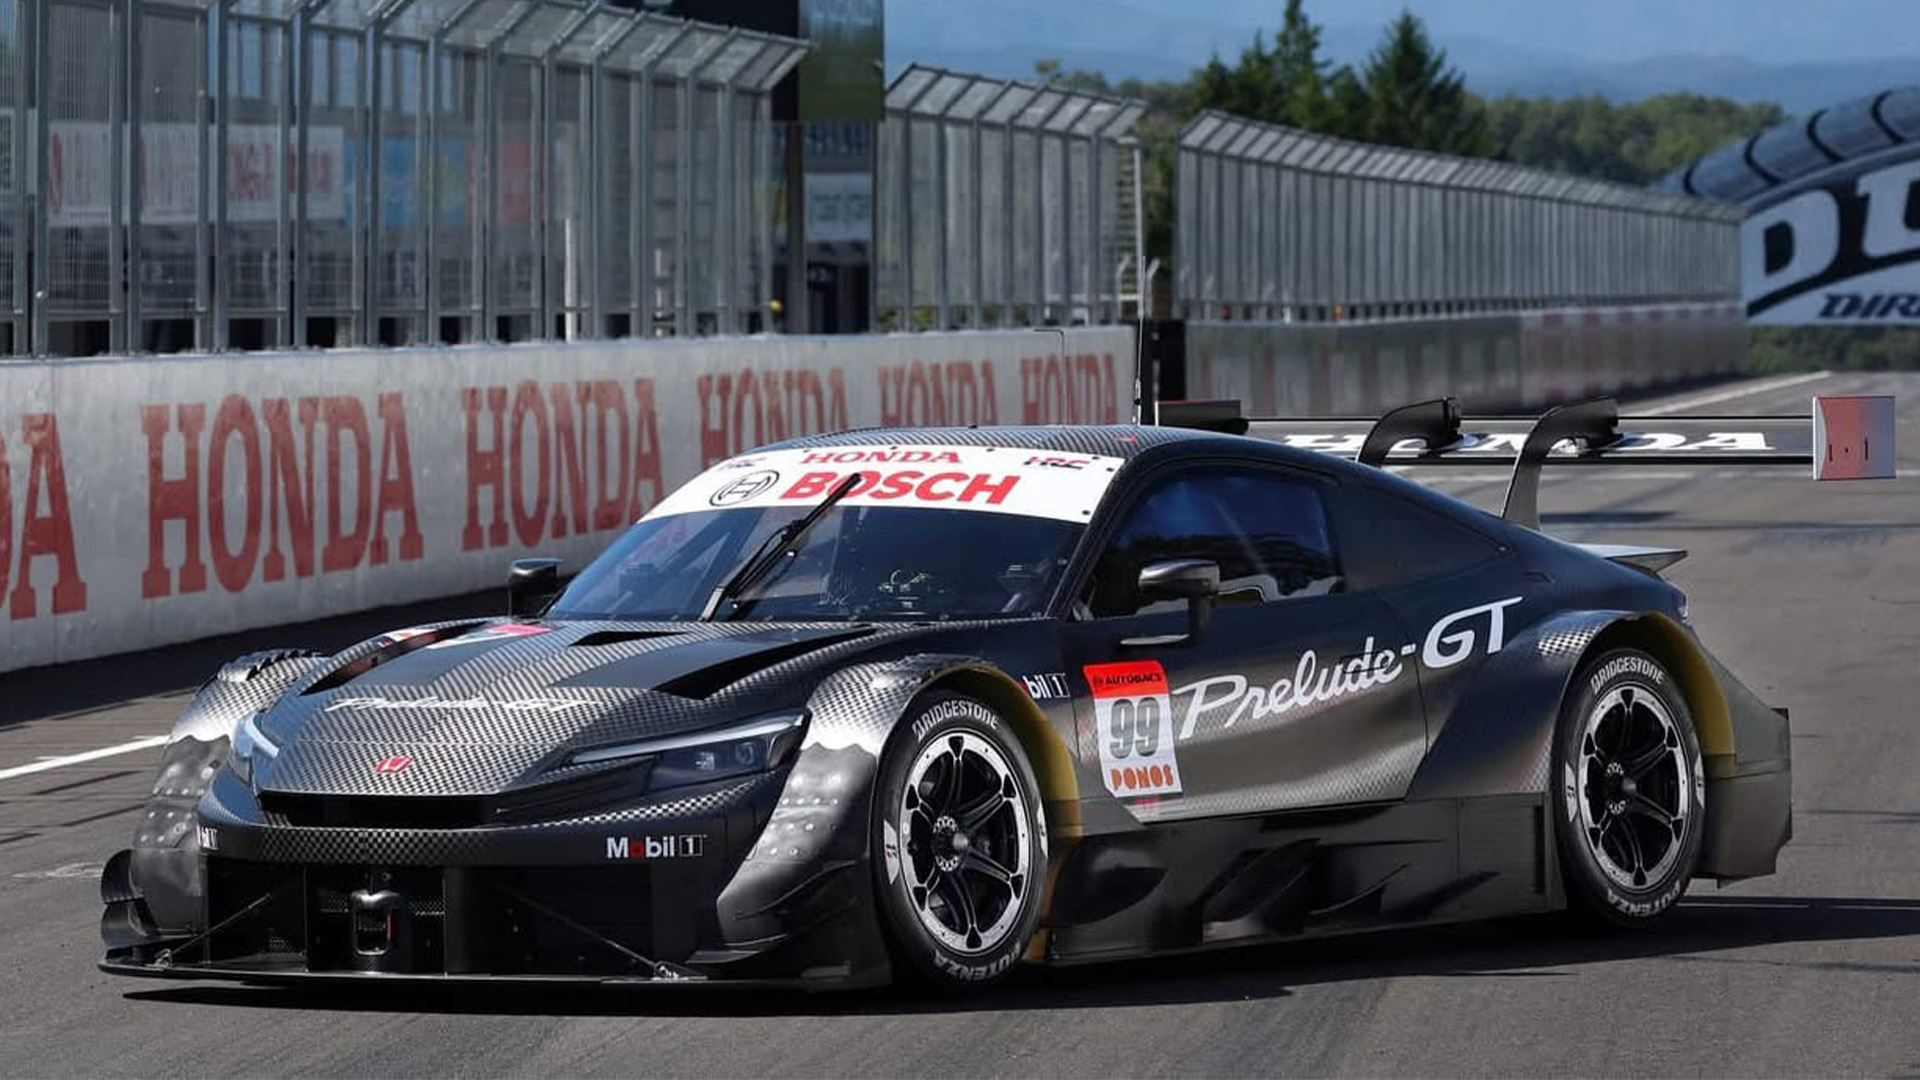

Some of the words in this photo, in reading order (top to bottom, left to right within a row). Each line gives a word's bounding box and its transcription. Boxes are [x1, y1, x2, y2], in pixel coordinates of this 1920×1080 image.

[878, 361, 998, 428] HONDA
[1021, 354, 1117, 425] HONDA
[462, 377, 664, 552] HONDA
[801, 450, 962, 464] HONDA
[140, 391, 424, 600] HONDA
[779, 471, 1021, 505] BOSCH
[0, 412, 87, 620] A
[1017, 674, 1051, 699] bil
[1172, 597, 1523, 741] Prelude-GT
[1590, 656, 1665, 695] BRIDGESTONE
[911, 699, 1000, 742] BRIDGESTONE
[1109, 697, 1160, 759] 99
[1110, 763, 1174, 791] PONOS
[606, 835, 675, 859] Mobil
[683, 835, 698, 857] 1
